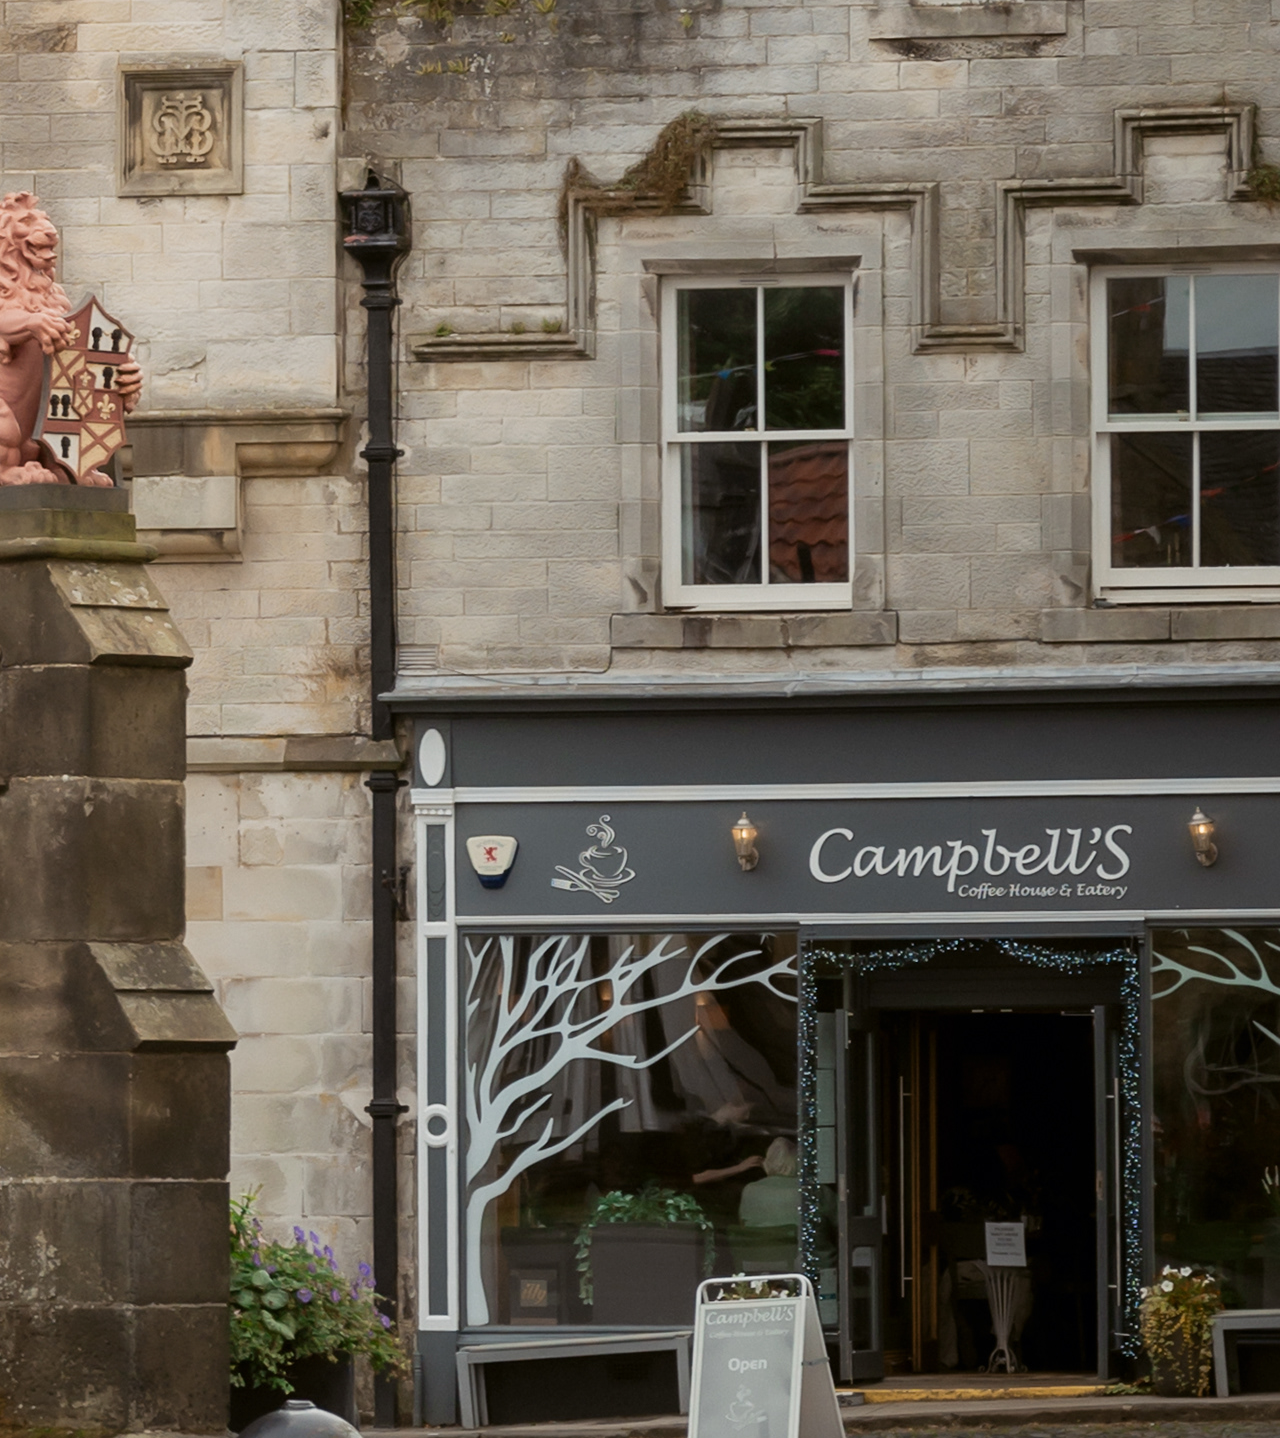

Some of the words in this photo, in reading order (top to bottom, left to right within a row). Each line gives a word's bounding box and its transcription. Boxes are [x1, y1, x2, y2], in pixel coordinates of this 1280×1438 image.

[958, 882, 1007, 899] Coffee
[1009, 883, 1058, 898] House
[1059, 883, 1072, 898] &
[1077, 883, 1128, 900] Eatery
[728, 1357, 768, 1374] Open
